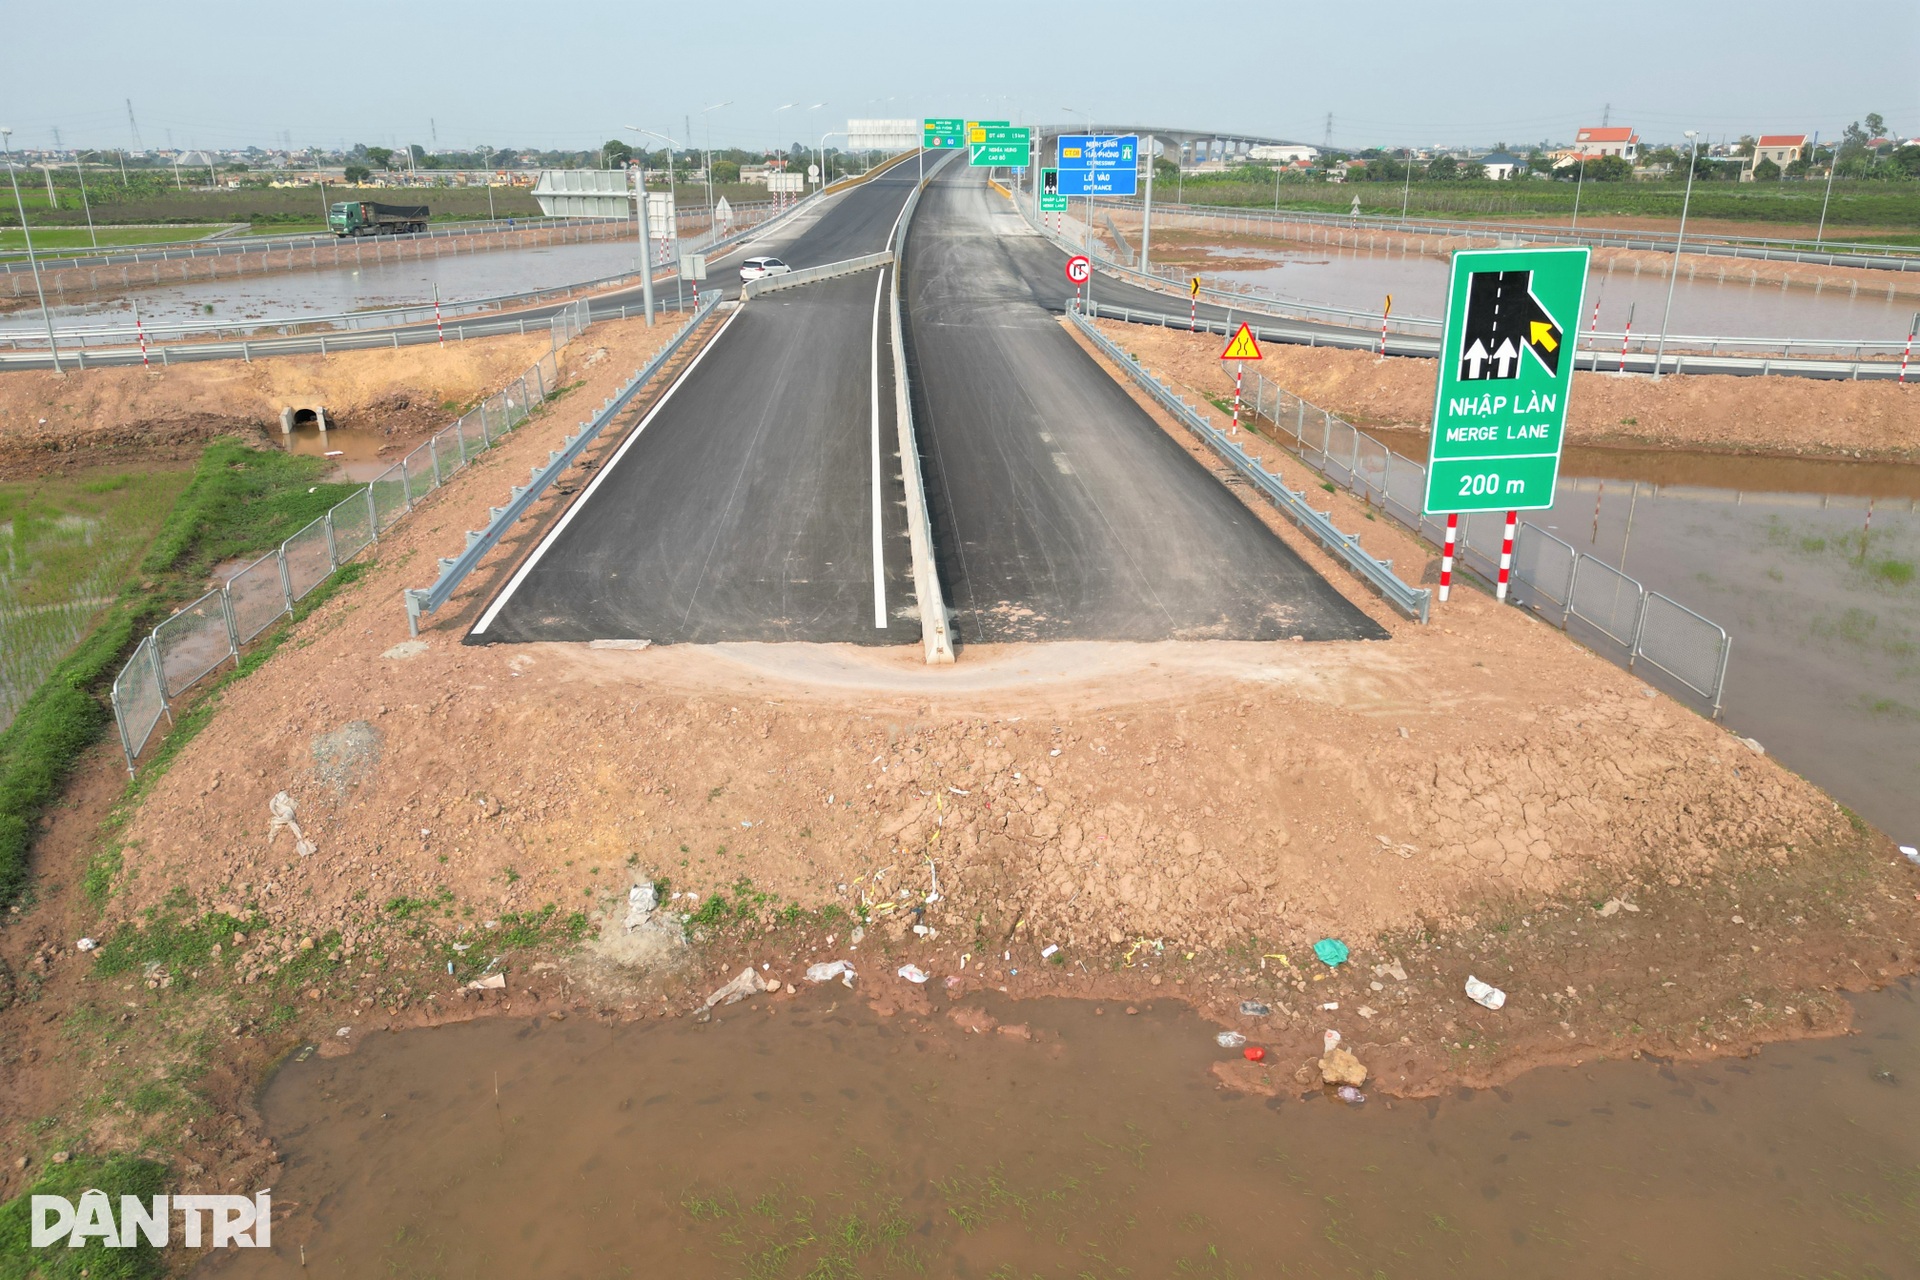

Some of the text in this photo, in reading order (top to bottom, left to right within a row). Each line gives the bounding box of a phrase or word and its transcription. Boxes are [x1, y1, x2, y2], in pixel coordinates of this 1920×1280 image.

[1083, 171, 1110, 181] LỐ VÀO
[1449, 390, 1556, 418] NHẬP LÀN
[1446, 424, 1549, 442] MERGE LANE
[1459, 474, 1525, 496] 200 m
